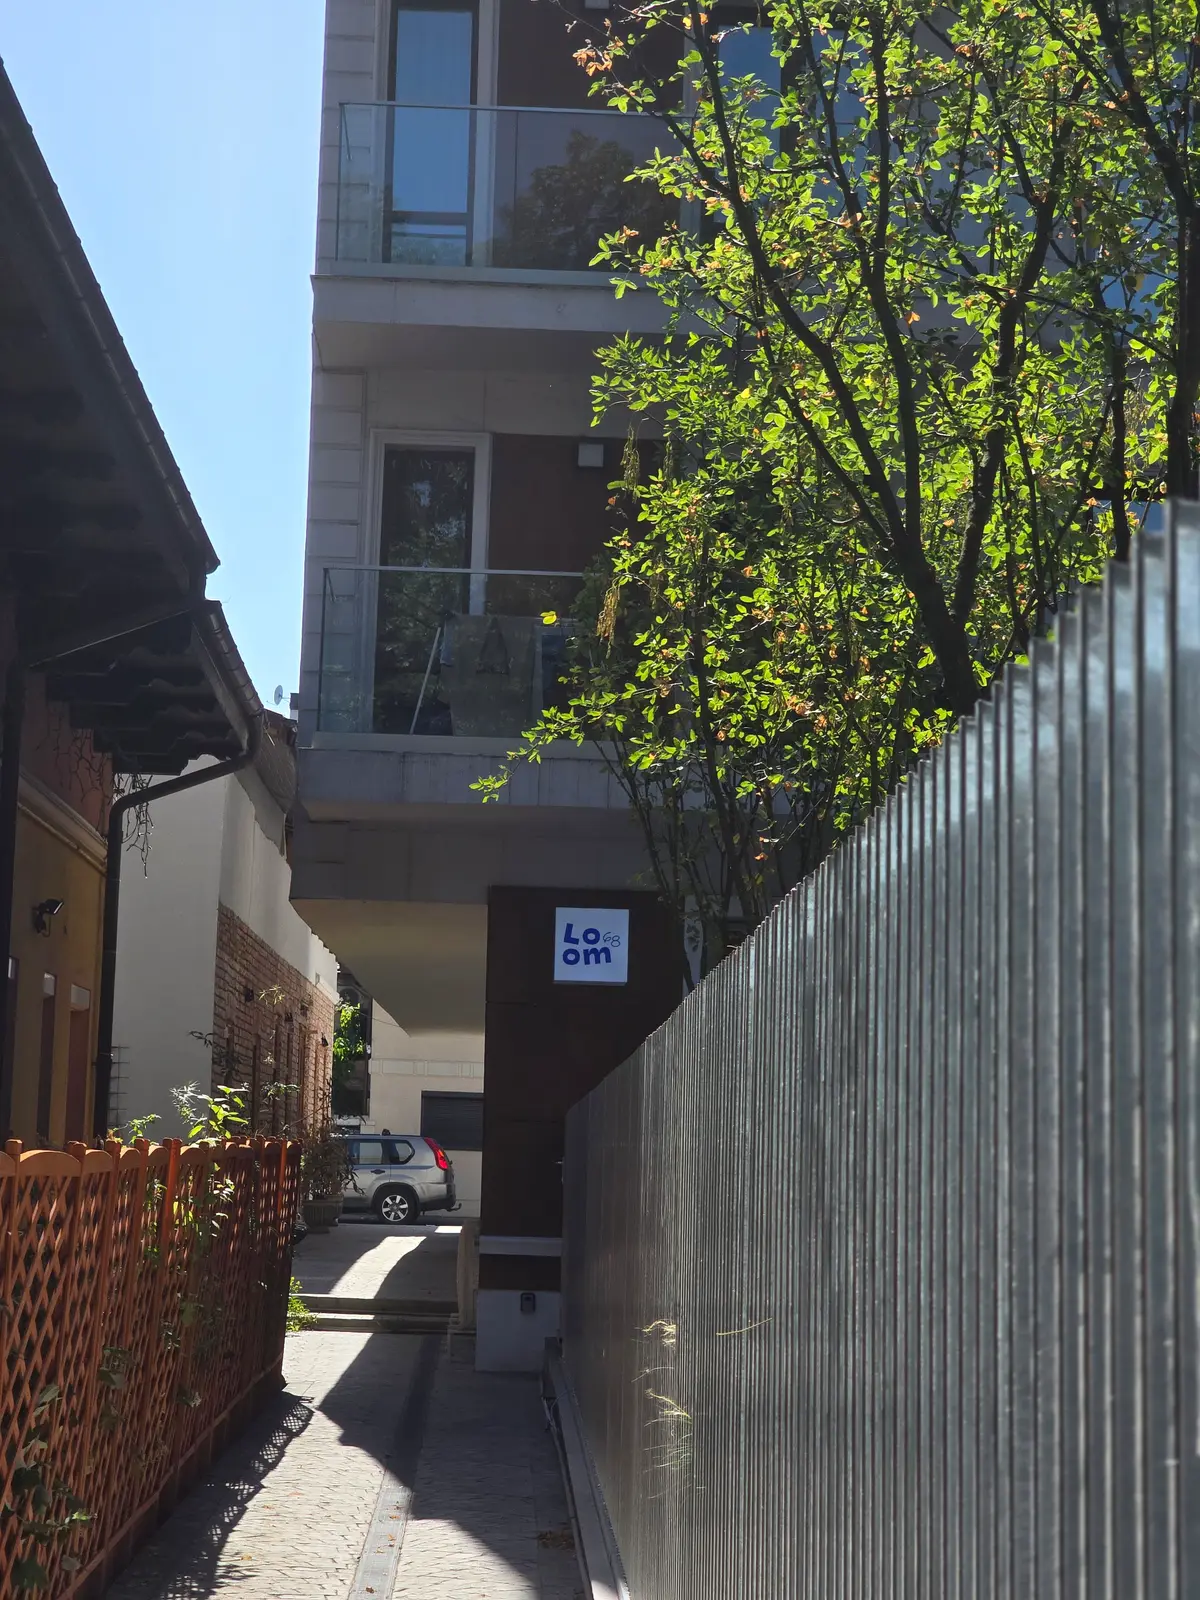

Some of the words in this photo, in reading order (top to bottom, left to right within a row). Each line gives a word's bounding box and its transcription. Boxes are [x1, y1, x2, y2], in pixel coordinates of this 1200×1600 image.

[563, 922, 601, 945] Lo
[602, 931, 621, 948] 68
[562, 946, 612, 966] om
